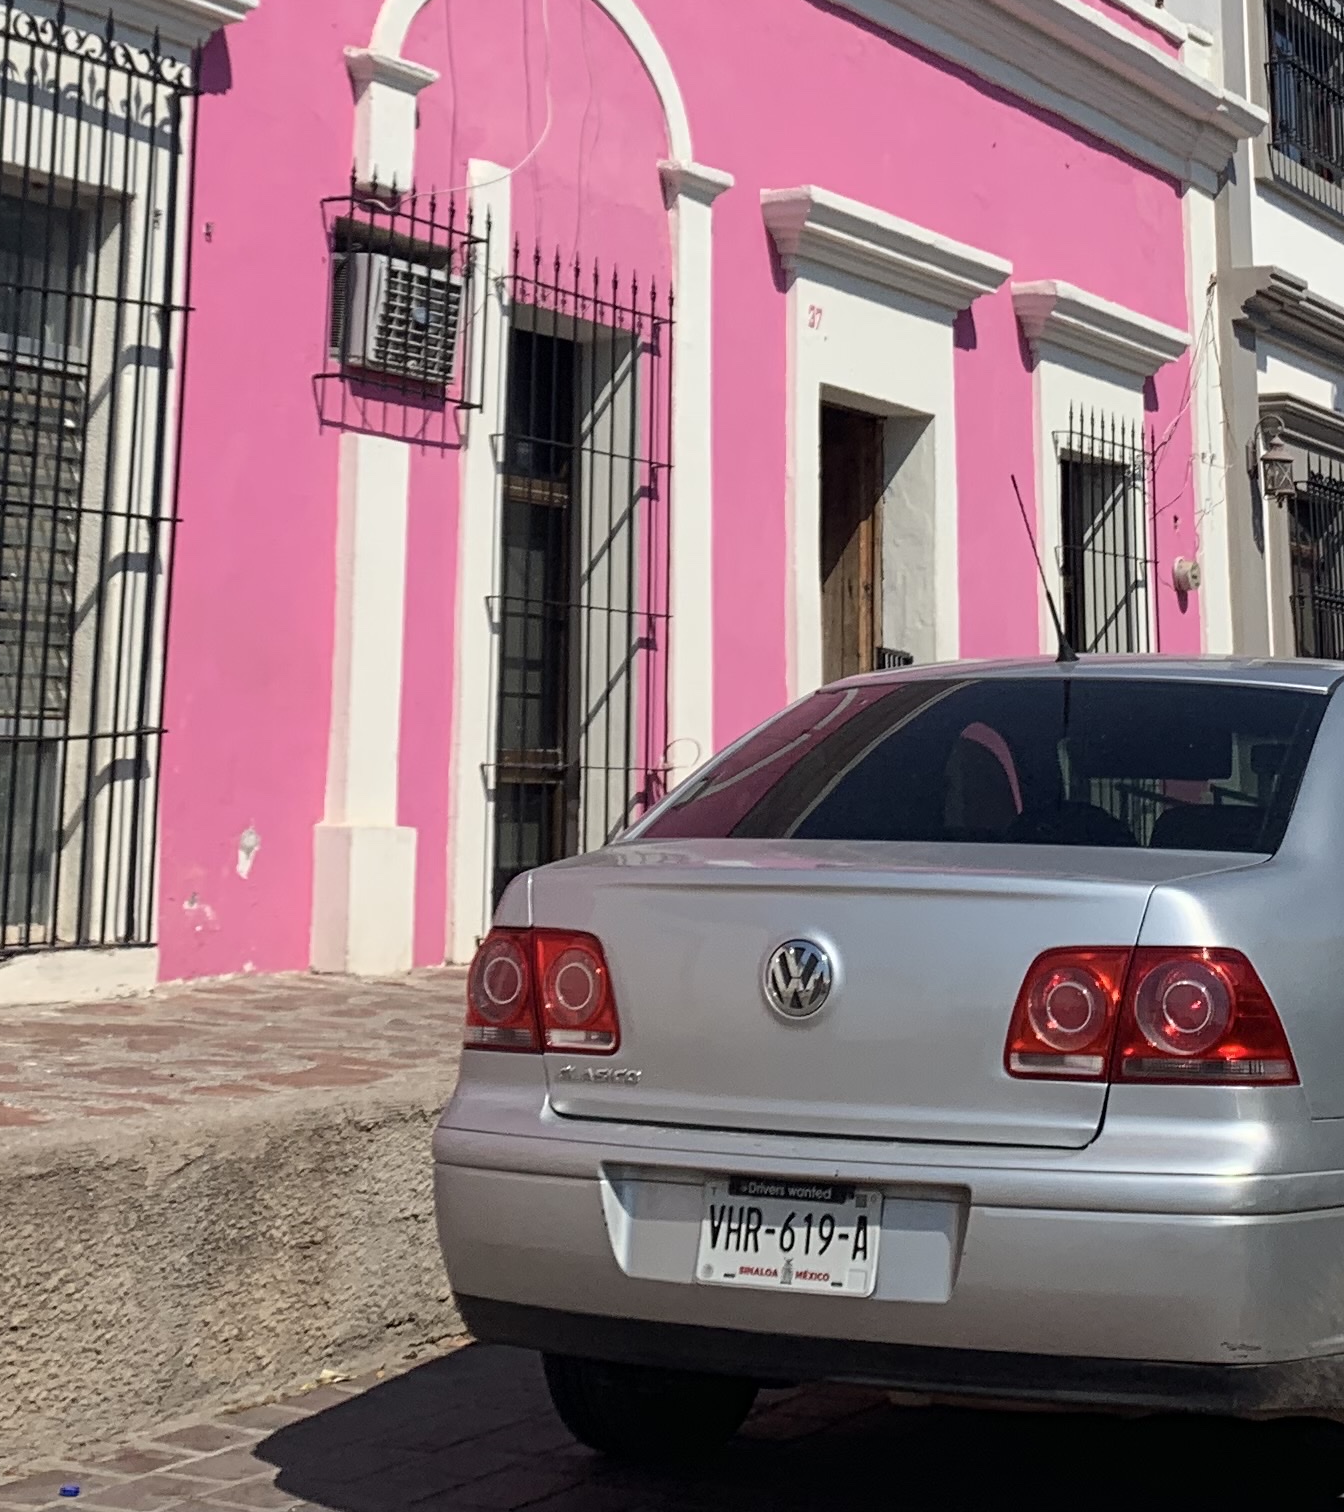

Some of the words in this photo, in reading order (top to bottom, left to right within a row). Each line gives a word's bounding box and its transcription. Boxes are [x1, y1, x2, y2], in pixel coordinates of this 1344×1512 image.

[748, 1182, 785, 1196] Drivers
[788, 1187, 832, 1200] wanted
[710, 1205, 868, 1261] VHR-619-A
[739, 1266, 778, 1278] SINALOA
